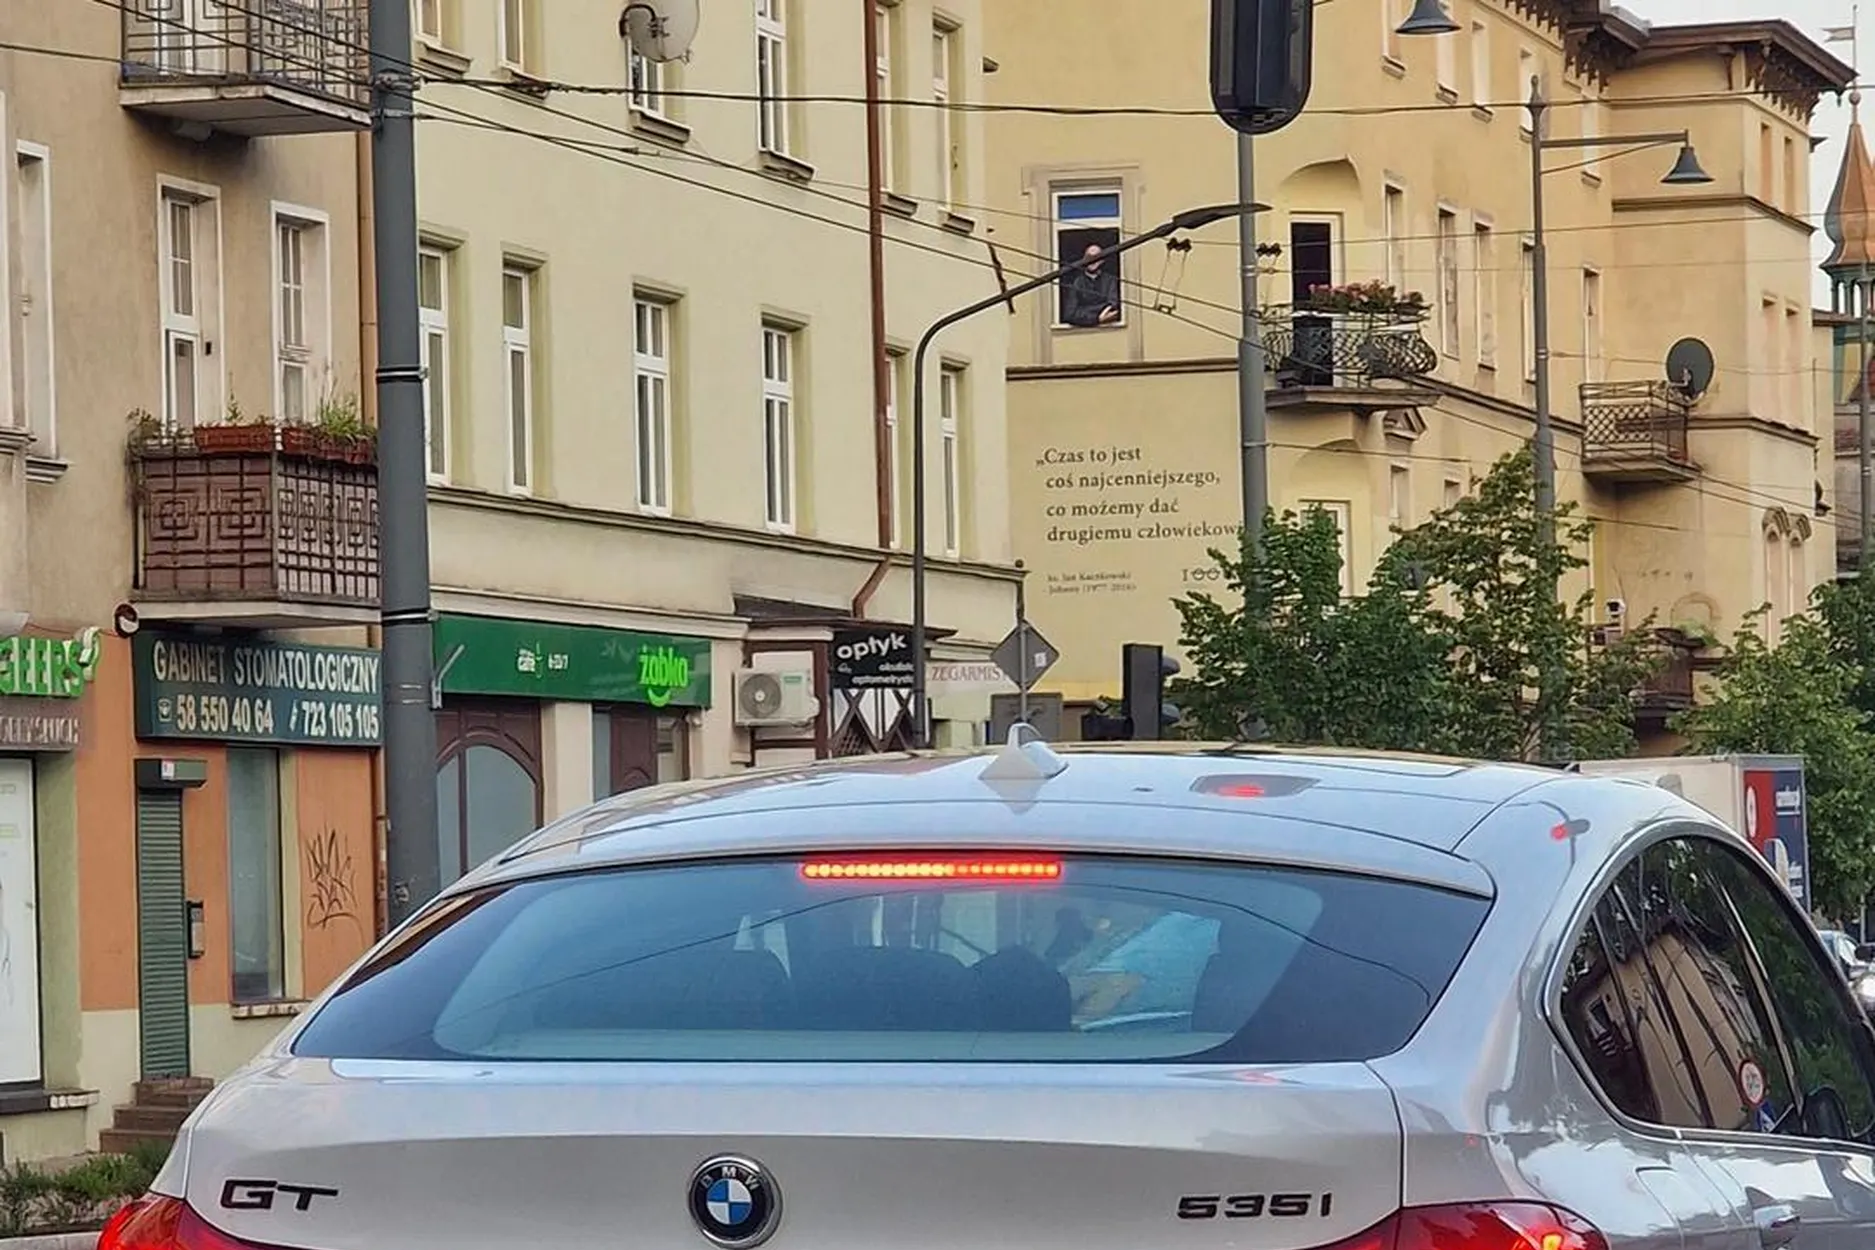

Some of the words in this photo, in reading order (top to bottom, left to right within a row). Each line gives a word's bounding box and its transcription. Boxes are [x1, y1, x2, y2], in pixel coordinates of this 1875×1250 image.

[1090, 449, 1107, 462] to
[1111, 446, 1141, 466] jest
[1046, 473, 1074, 488] coś
[1079, 470, 1221, 491] najcenniejszego,
[1046, 504, 1066, 517] co
[1071, 500, 1144, 518] możemy
[1149, 497, 1180, 514] dać
[1047, 526, 1132, 546] drugiemu
[836, 632, 907, 660] optyk
[153, 640, 226, 684] GABINET
[234, 648, 379, 694] STOMATOLOGICZNY
[638, 644, 689, 687] żabka
[931, 666, 1008, 681] ZEGARMIS
[176, 694, 197, 731] 58
[200, 696, 228, 732] 550
[231, 698, 251, 733] 40
[254, 699, 274, 734] 64
[302, 701, 326, 737] 723
[329, 702, 353, 738] 105
[355, 704, 379, 739] 105
[701, 1166, 760, 1190] BMW
[220, 1180, 339, 1211] GT
